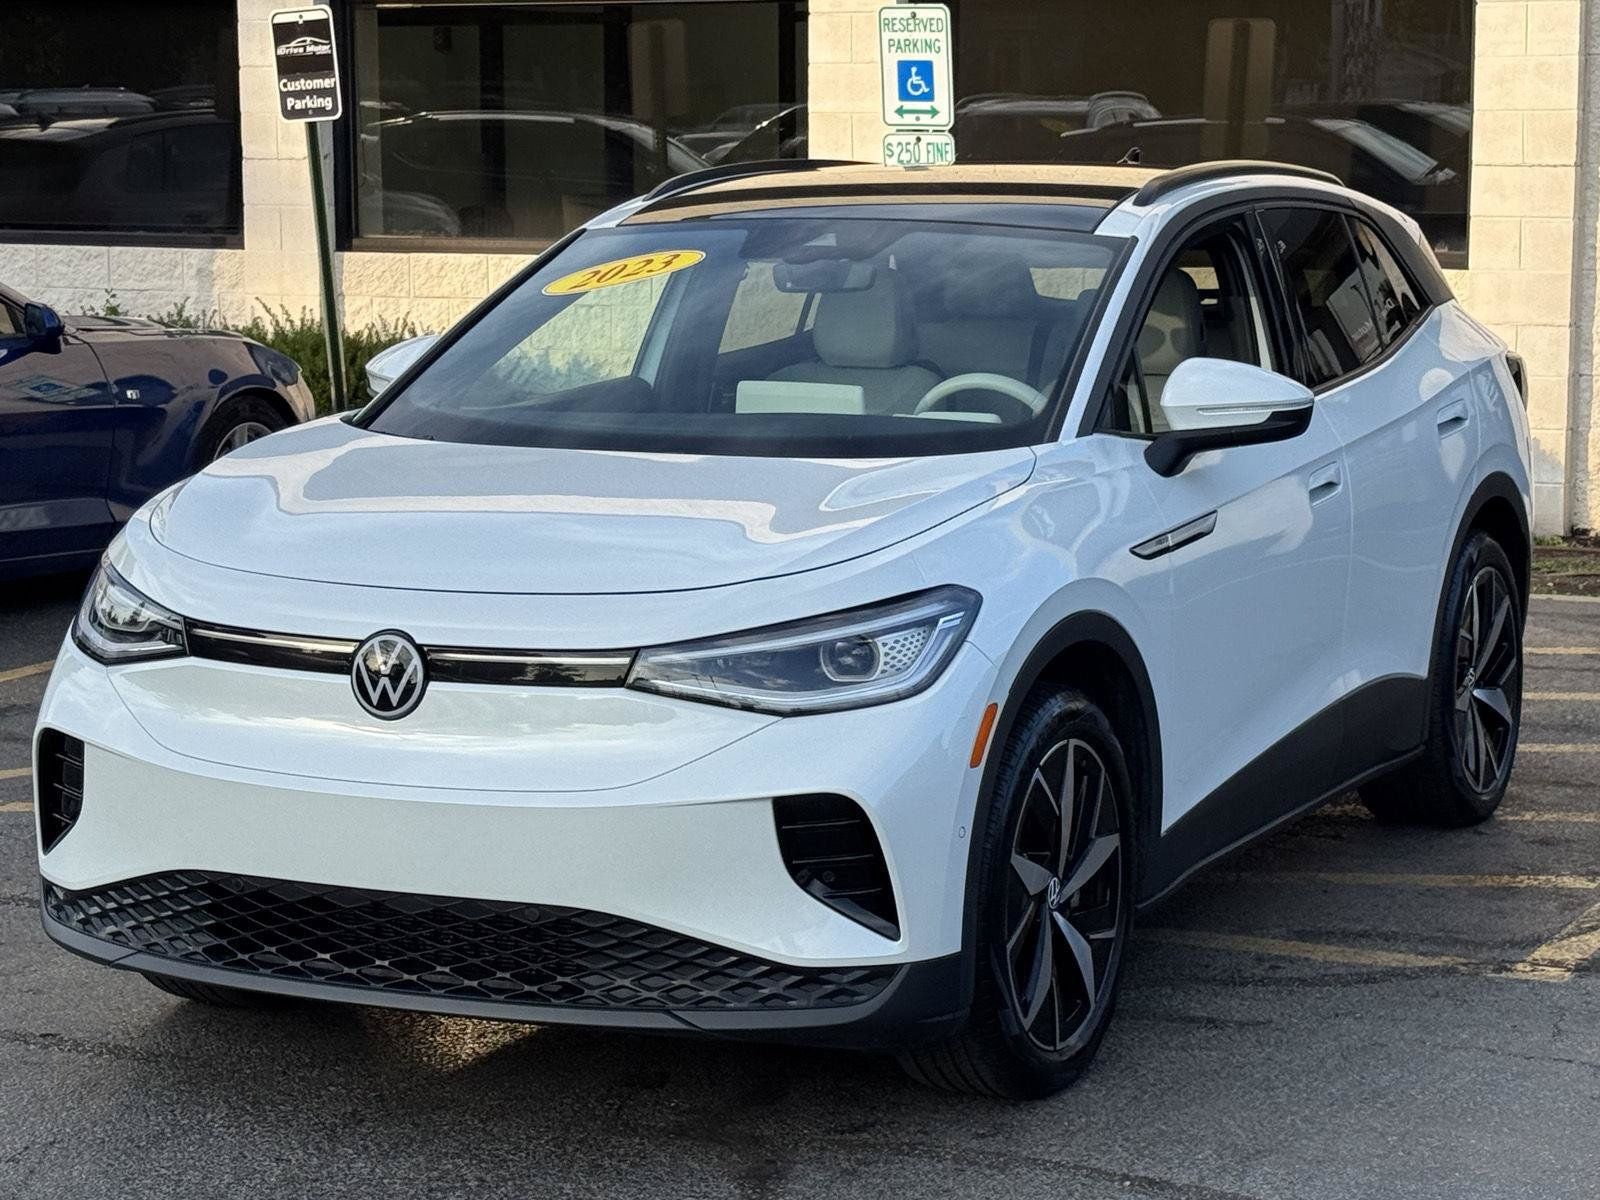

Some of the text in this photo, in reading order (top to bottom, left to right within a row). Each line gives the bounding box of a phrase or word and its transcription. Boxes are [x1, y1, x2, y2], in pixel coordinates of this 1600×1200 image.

[882, 17, 944, 33] RESERVED
[887, 38, 942, 54] PARKING
[279, 78, 336, 92] Customer
[286, 95, 333, 111] Parking
[926, 142, 951, 164] FINE
[569, 253, 682, 289] 2023
[353, 636, 422, 712] VW
